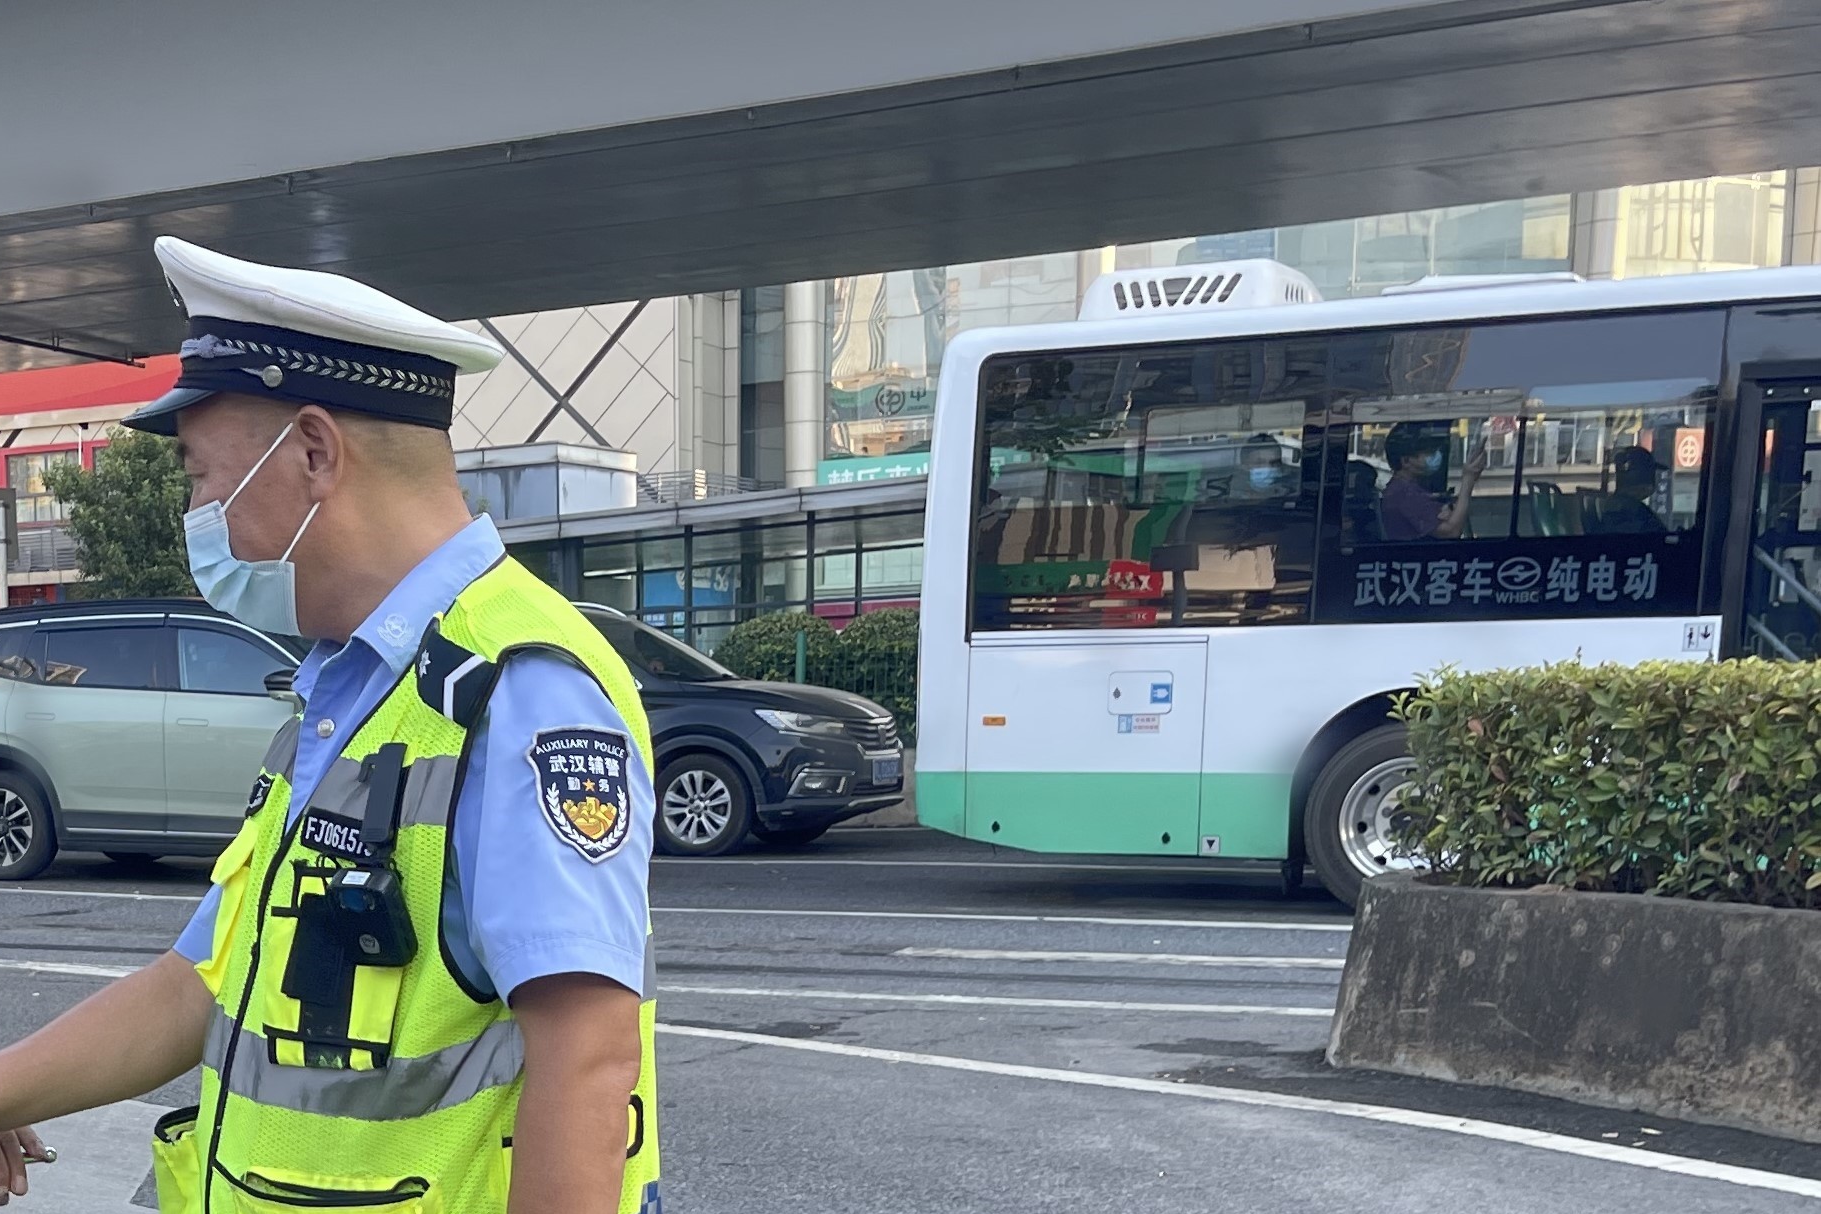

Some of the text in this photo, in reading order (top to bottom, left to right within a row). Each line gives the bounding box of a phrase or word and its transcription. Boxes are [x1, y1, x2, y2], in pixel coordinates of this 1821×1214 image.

[1354, 558, 1494, 606] 武汉客车
[1545, 552, 1659, 603] 纯电动
[535, 739, 625, 758] AUXILIARY POLICE
[548, 754, 620, 777] 武汉辅警
